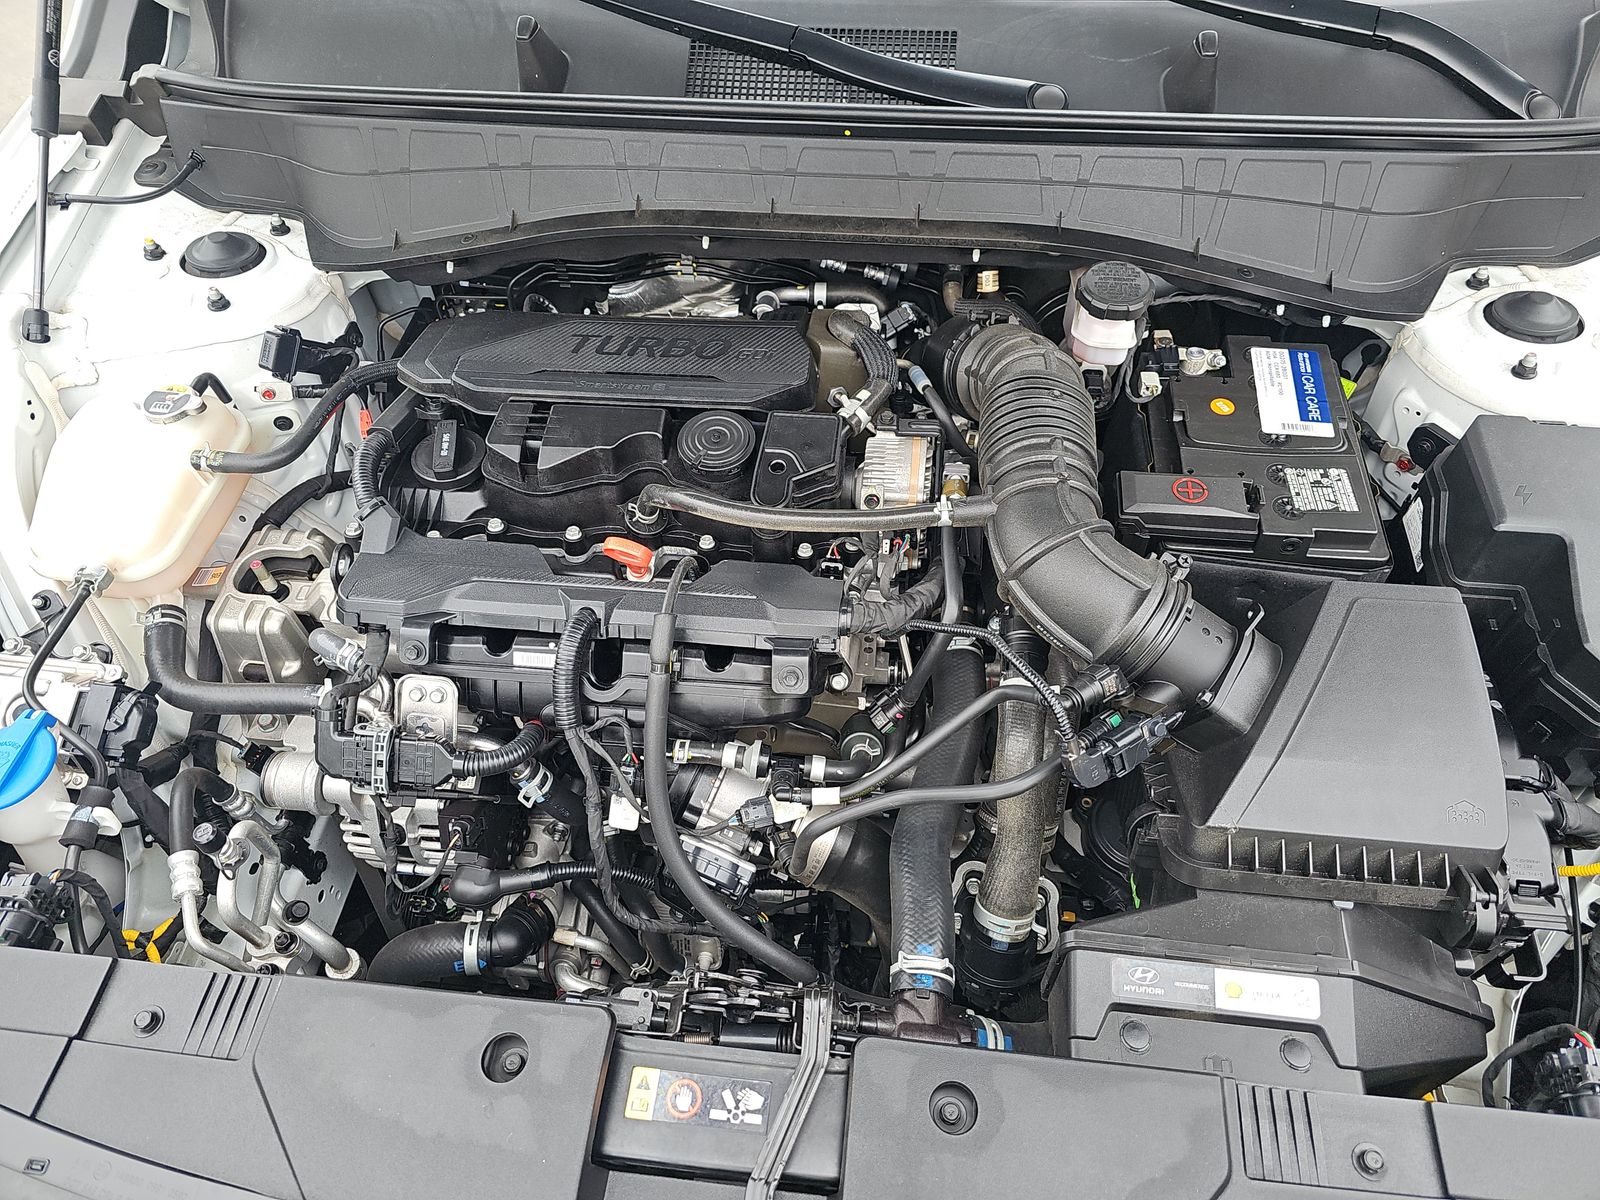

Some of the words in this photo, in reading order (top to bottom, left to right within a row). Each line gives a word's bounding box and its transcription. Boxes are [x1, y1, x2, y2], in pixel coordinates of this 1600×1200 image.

[571, 334, 732, 359] TURBO
[1301, 375, 1316, 395] CAR
[1305, 396, 1322, 421] CARE
[1123, 984, 1165, 996] HYUNDAI
